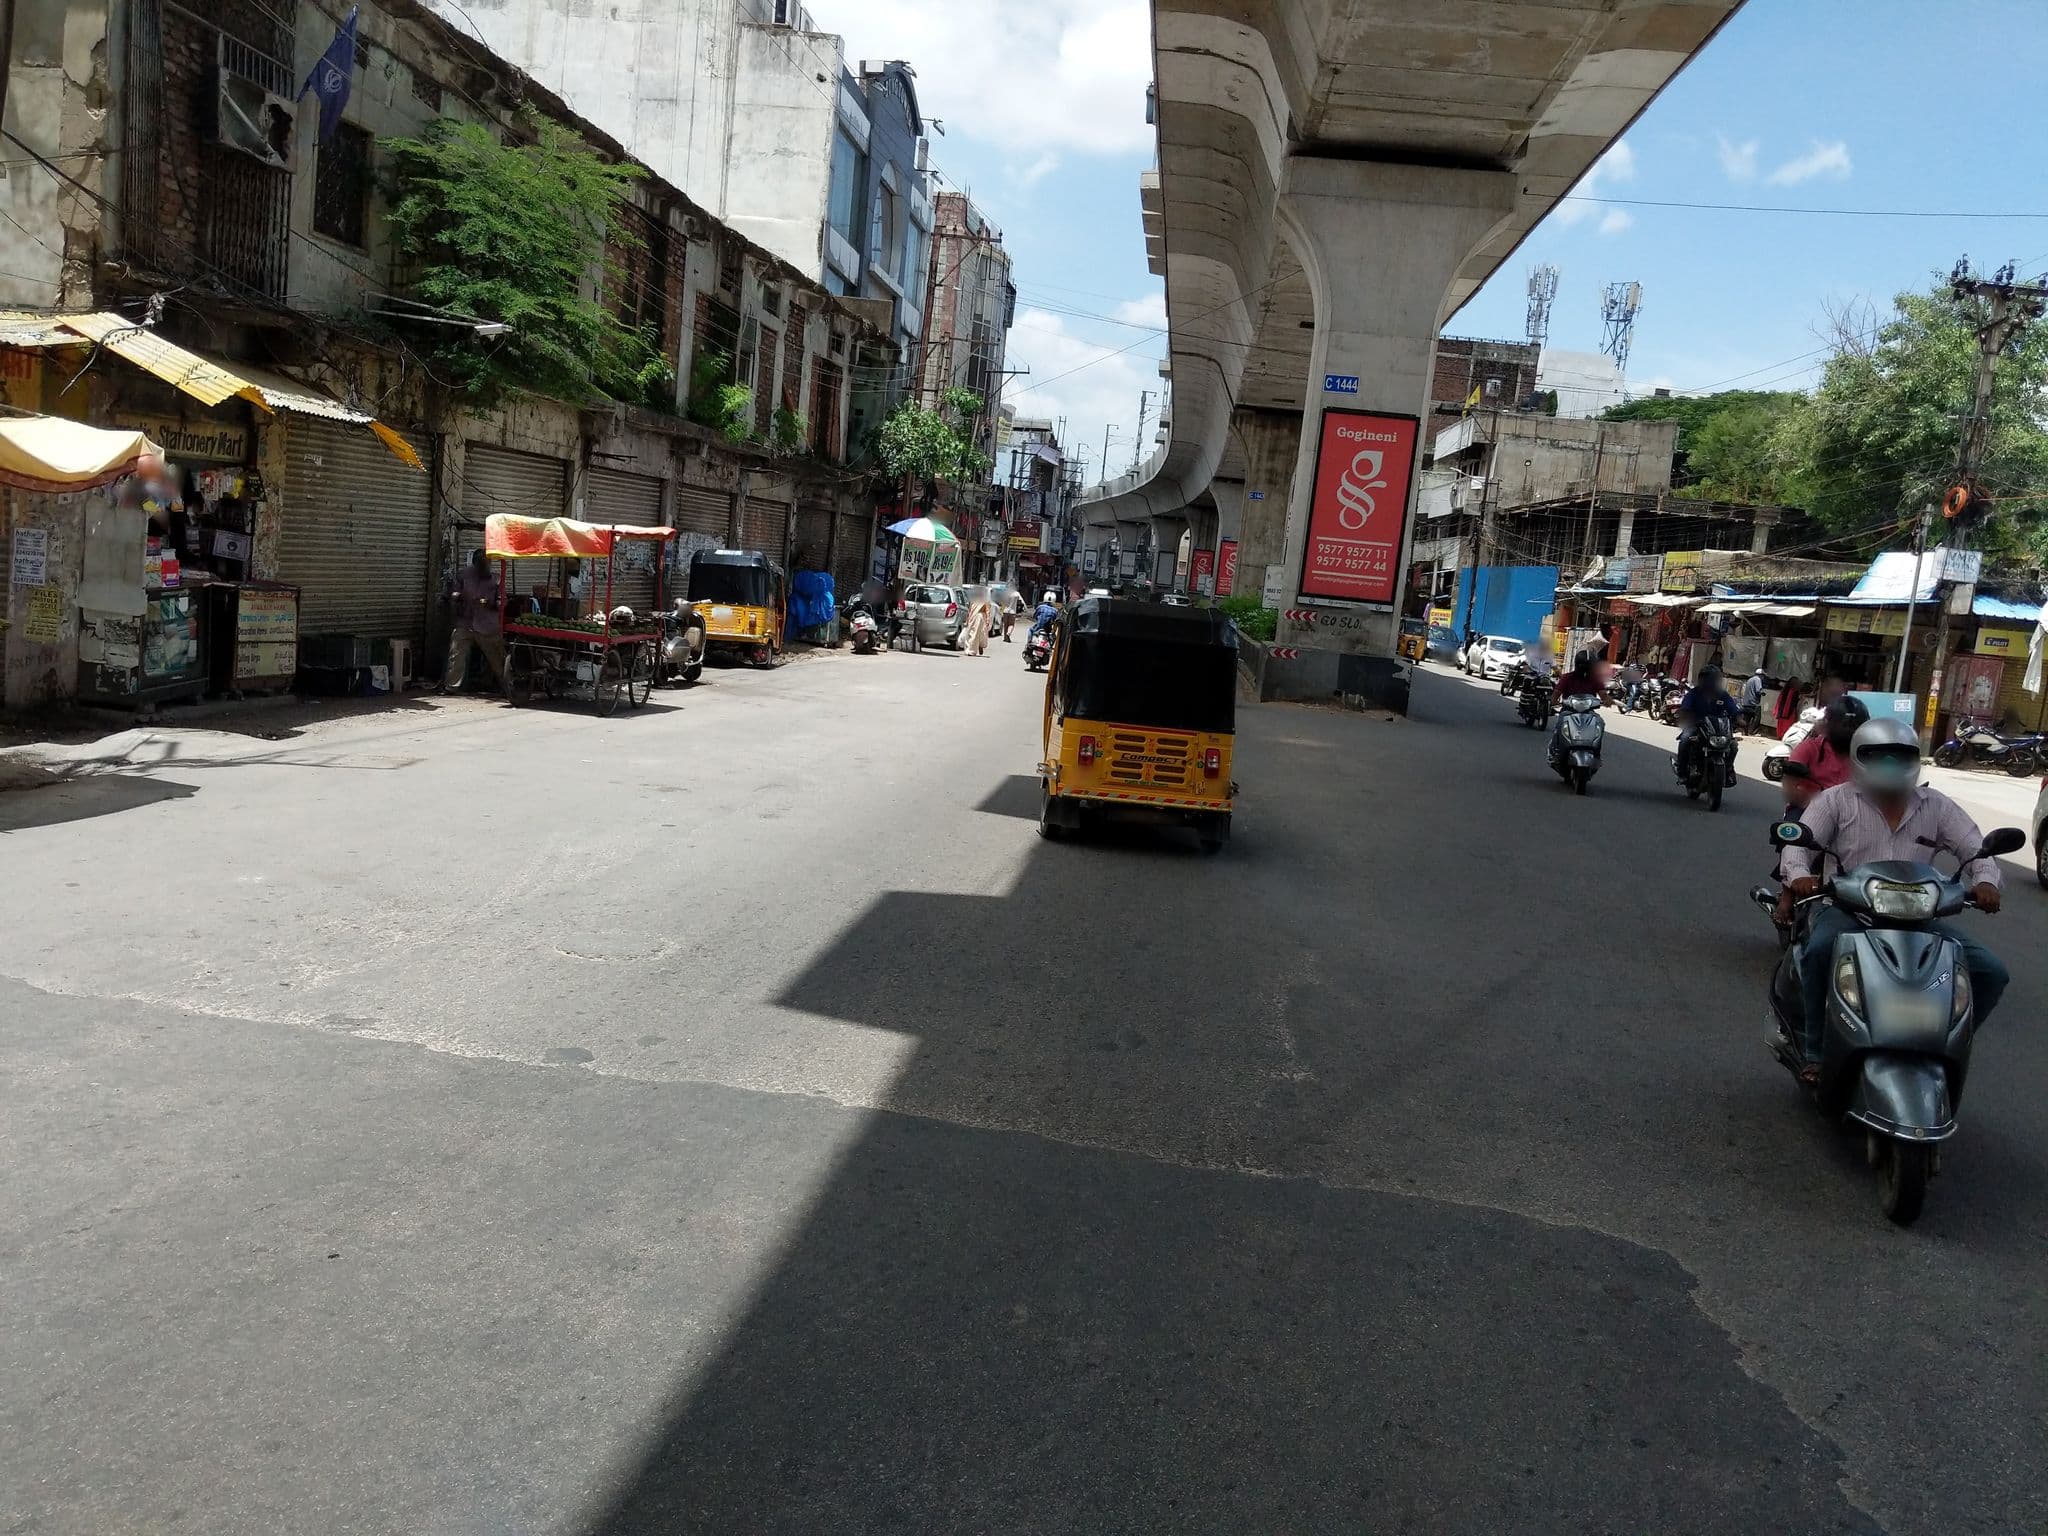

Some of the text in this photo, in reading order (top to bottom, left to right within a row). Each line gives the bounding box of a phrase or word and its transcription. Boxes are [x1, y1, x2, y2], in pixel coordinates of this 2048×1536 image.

[1325, 378, 1358, 391] C 1444
[158, 425, 216, 456] Stationery
[217, 431, 244, 456] Mart
[1336, 426, 1398, 443] Gogineni
[1317, 543, 1388, 560] 9577 9577 11
[1316, 555, 1387, 572] 9577 9577 44
[1321, 616, 1362, 629] GO SLO
[1120, 752, 1179, 765] Compact
[1786, 826, 1792, 835] 9
[1840, 1012, 1857, 1032] SUZUKI
